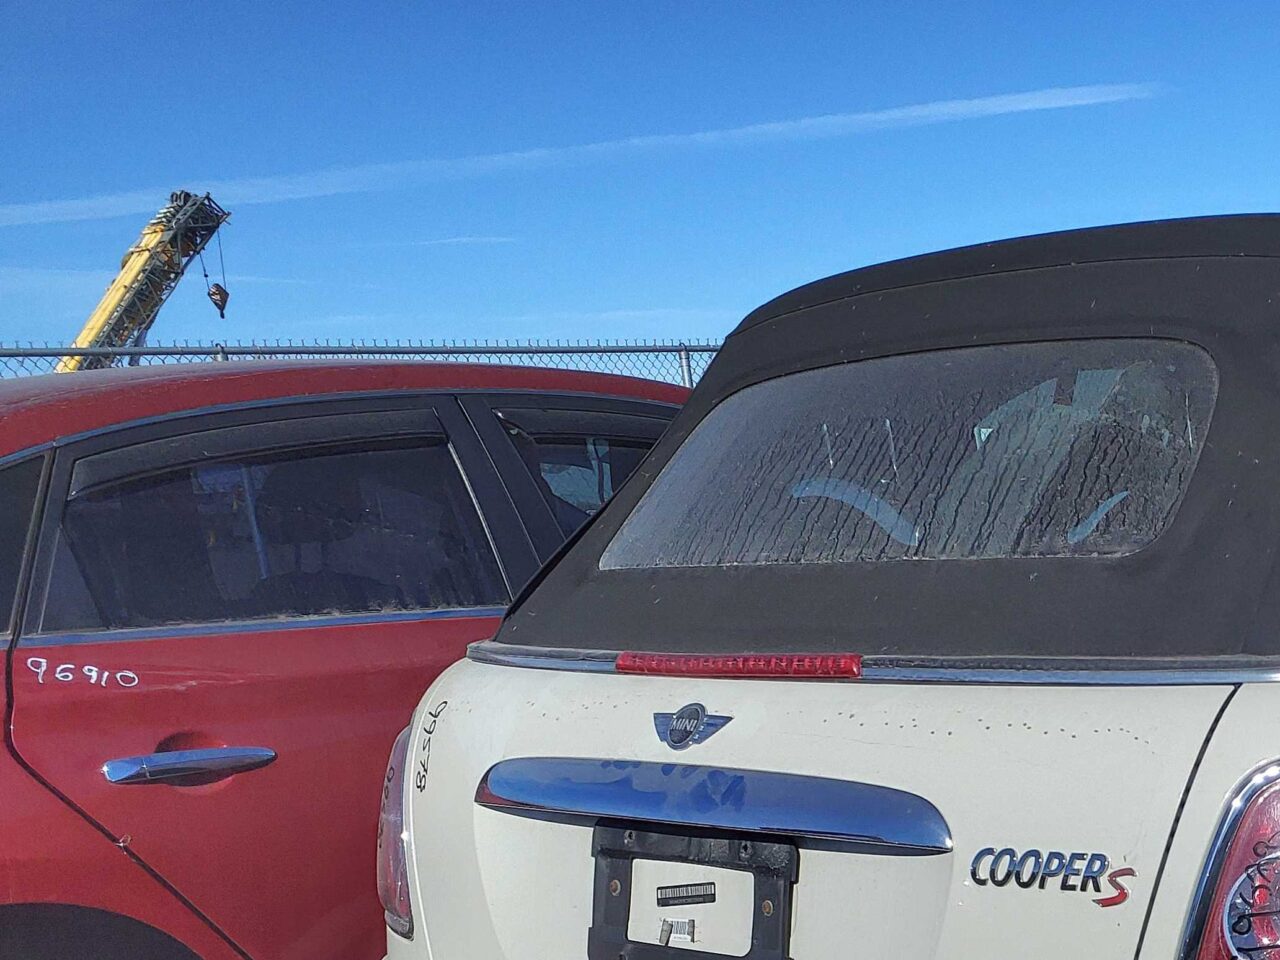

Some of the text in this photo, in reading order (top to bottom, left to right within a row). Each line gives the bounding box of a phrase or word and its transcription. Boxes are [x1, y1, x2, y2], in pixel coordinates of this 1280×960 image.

[26, 657, 139, 687] 96910
[416, 700, 448, 793] 99578
[671, 718, 698, 732] MINI
[970, 847, 1138, 908] COOPER S
